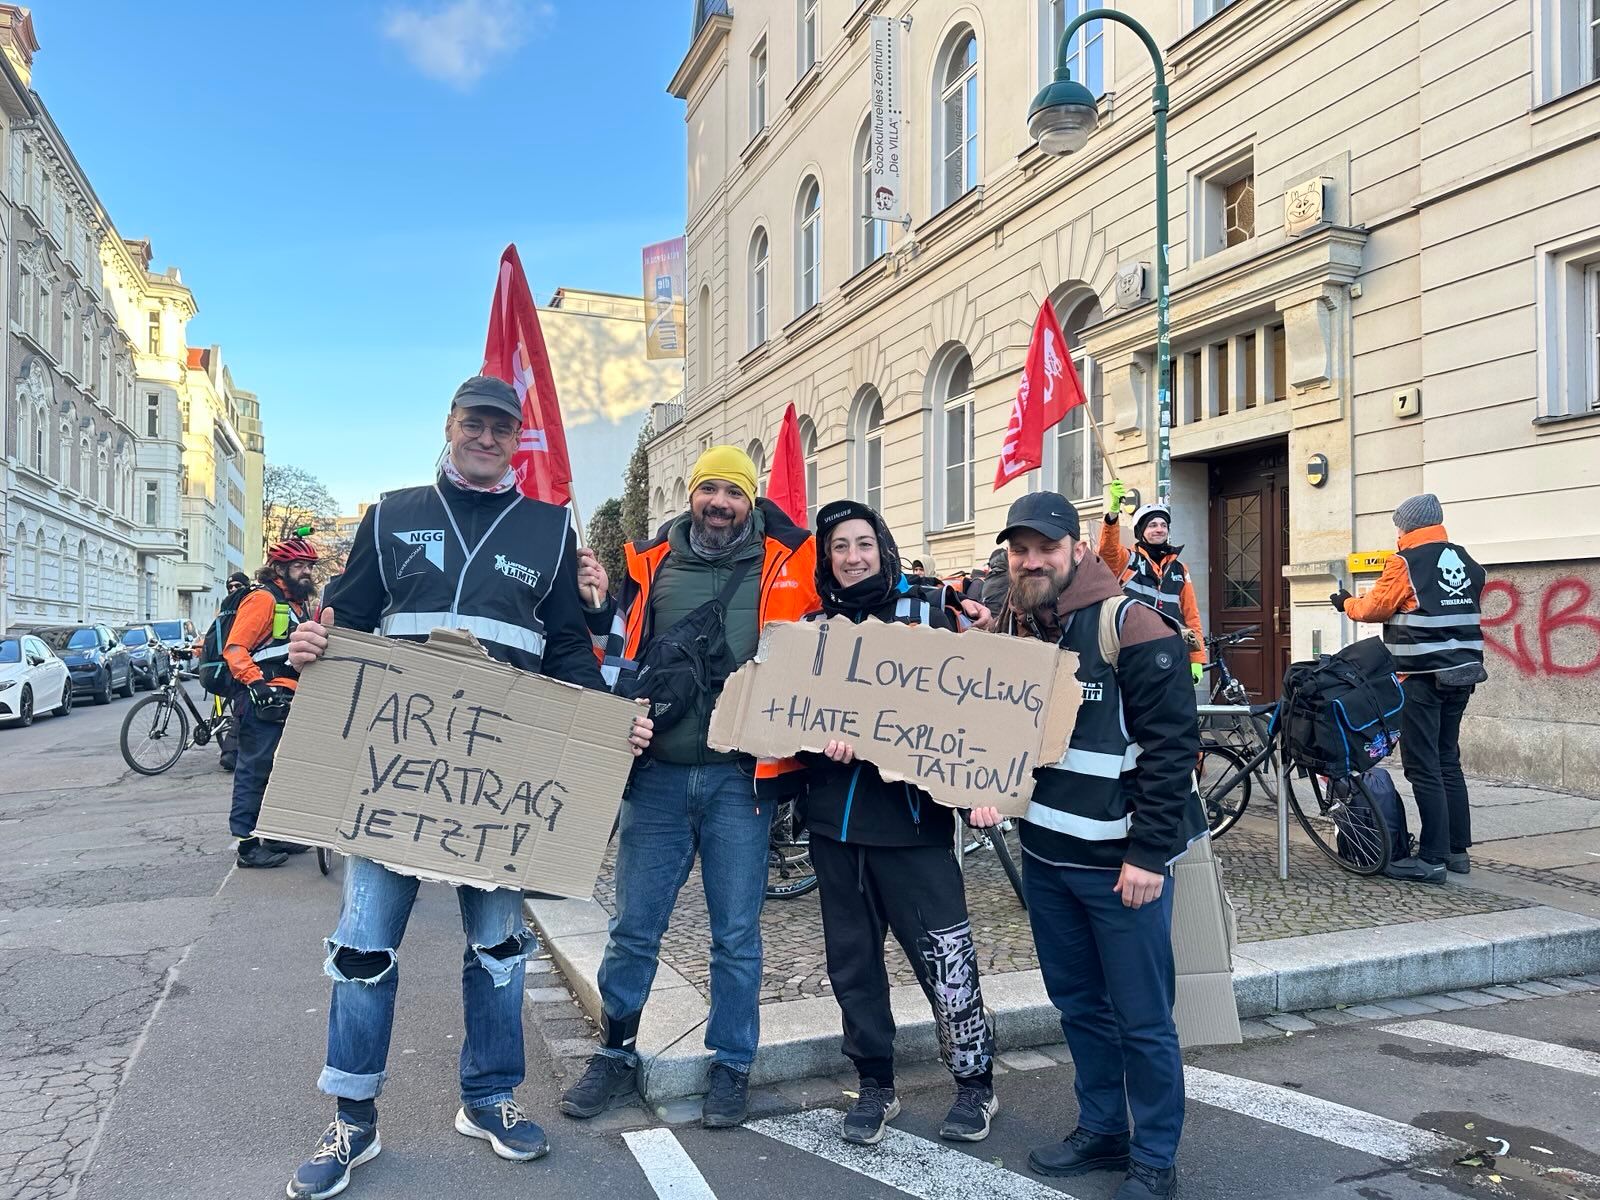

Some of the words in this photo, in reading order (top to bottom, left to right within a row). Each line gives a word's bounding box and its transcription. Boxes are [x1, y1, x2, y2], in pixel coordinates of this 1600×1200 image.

[874, 39, 884, 87] Zentrum
[874, 89, 884, 175] Soziokulturelles
[1399, 395, 1407, 409] 7
[410, 532, 443, 542] NGG
[507, 566, 538, 587] LIMIT
[844, 636, 934, 692] LOVE
[366, 744, 569, 832] VERTRAG
